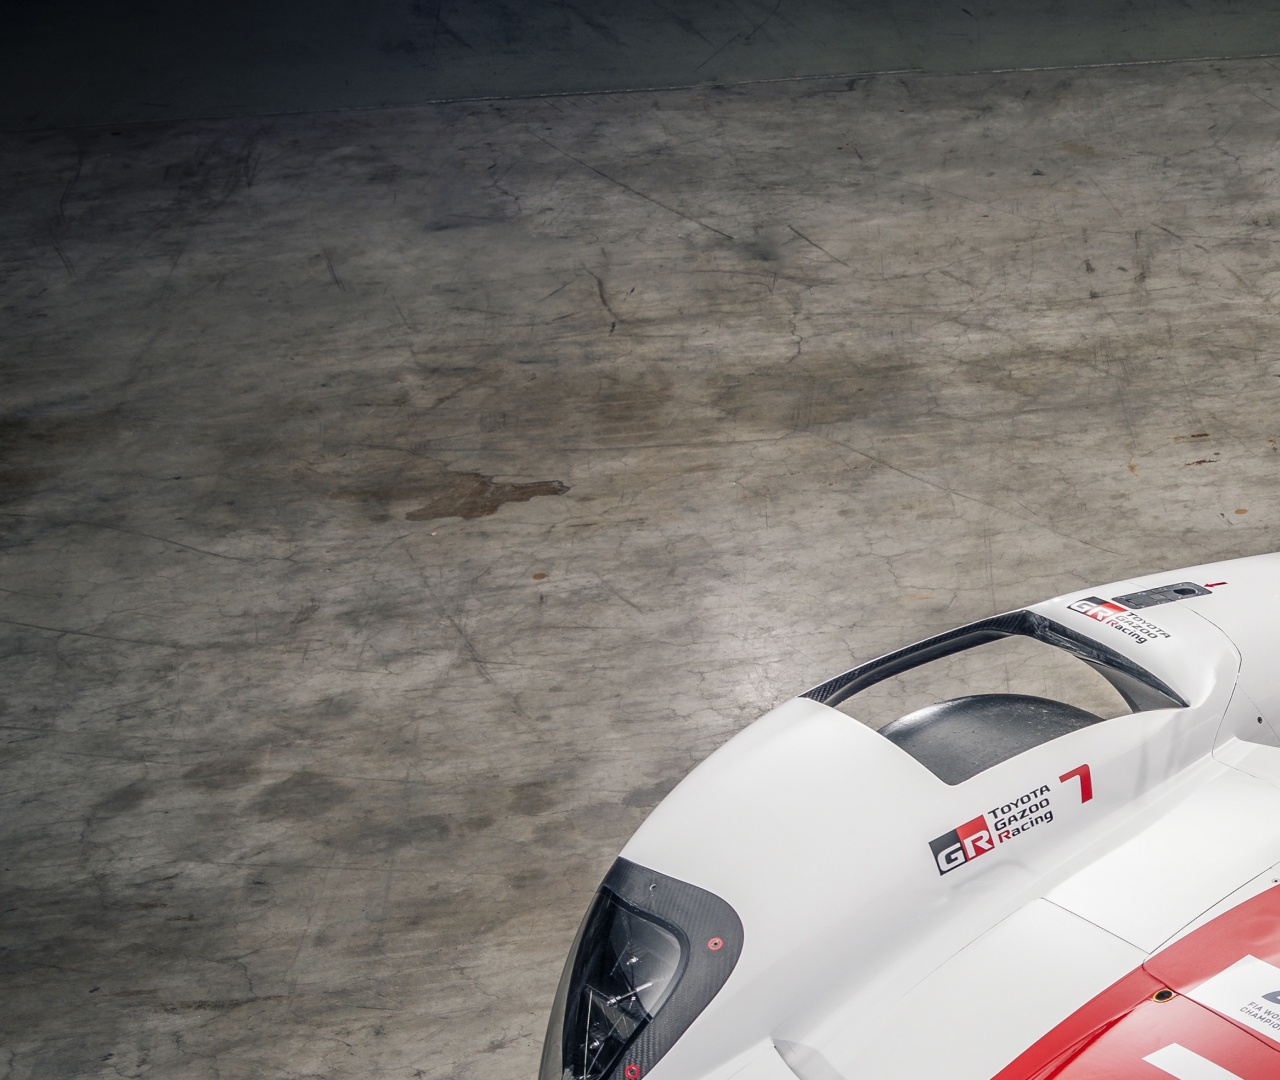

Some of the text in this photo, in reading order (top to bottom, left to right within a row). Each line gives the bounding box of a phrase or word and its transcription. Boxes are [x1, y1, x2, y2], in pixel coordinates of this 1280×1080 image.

[1069, 599, 1113, 621] GR
[1106, 619, 1148, 644] Racing
[1115, 616, 1159, 639] GAZOO
[1127, 612, 1171, 639] TOYOTA
[1059, 764, 1093, 804] 7
[988, 784, 1051, 820] TOYOTA
[994, 798, 1050, 832] GAZOO
[998, 810, 1054, 844] Racing
[937, 829, 994, 872] GR
[1248, 1001, 1264, 1013] FIA
